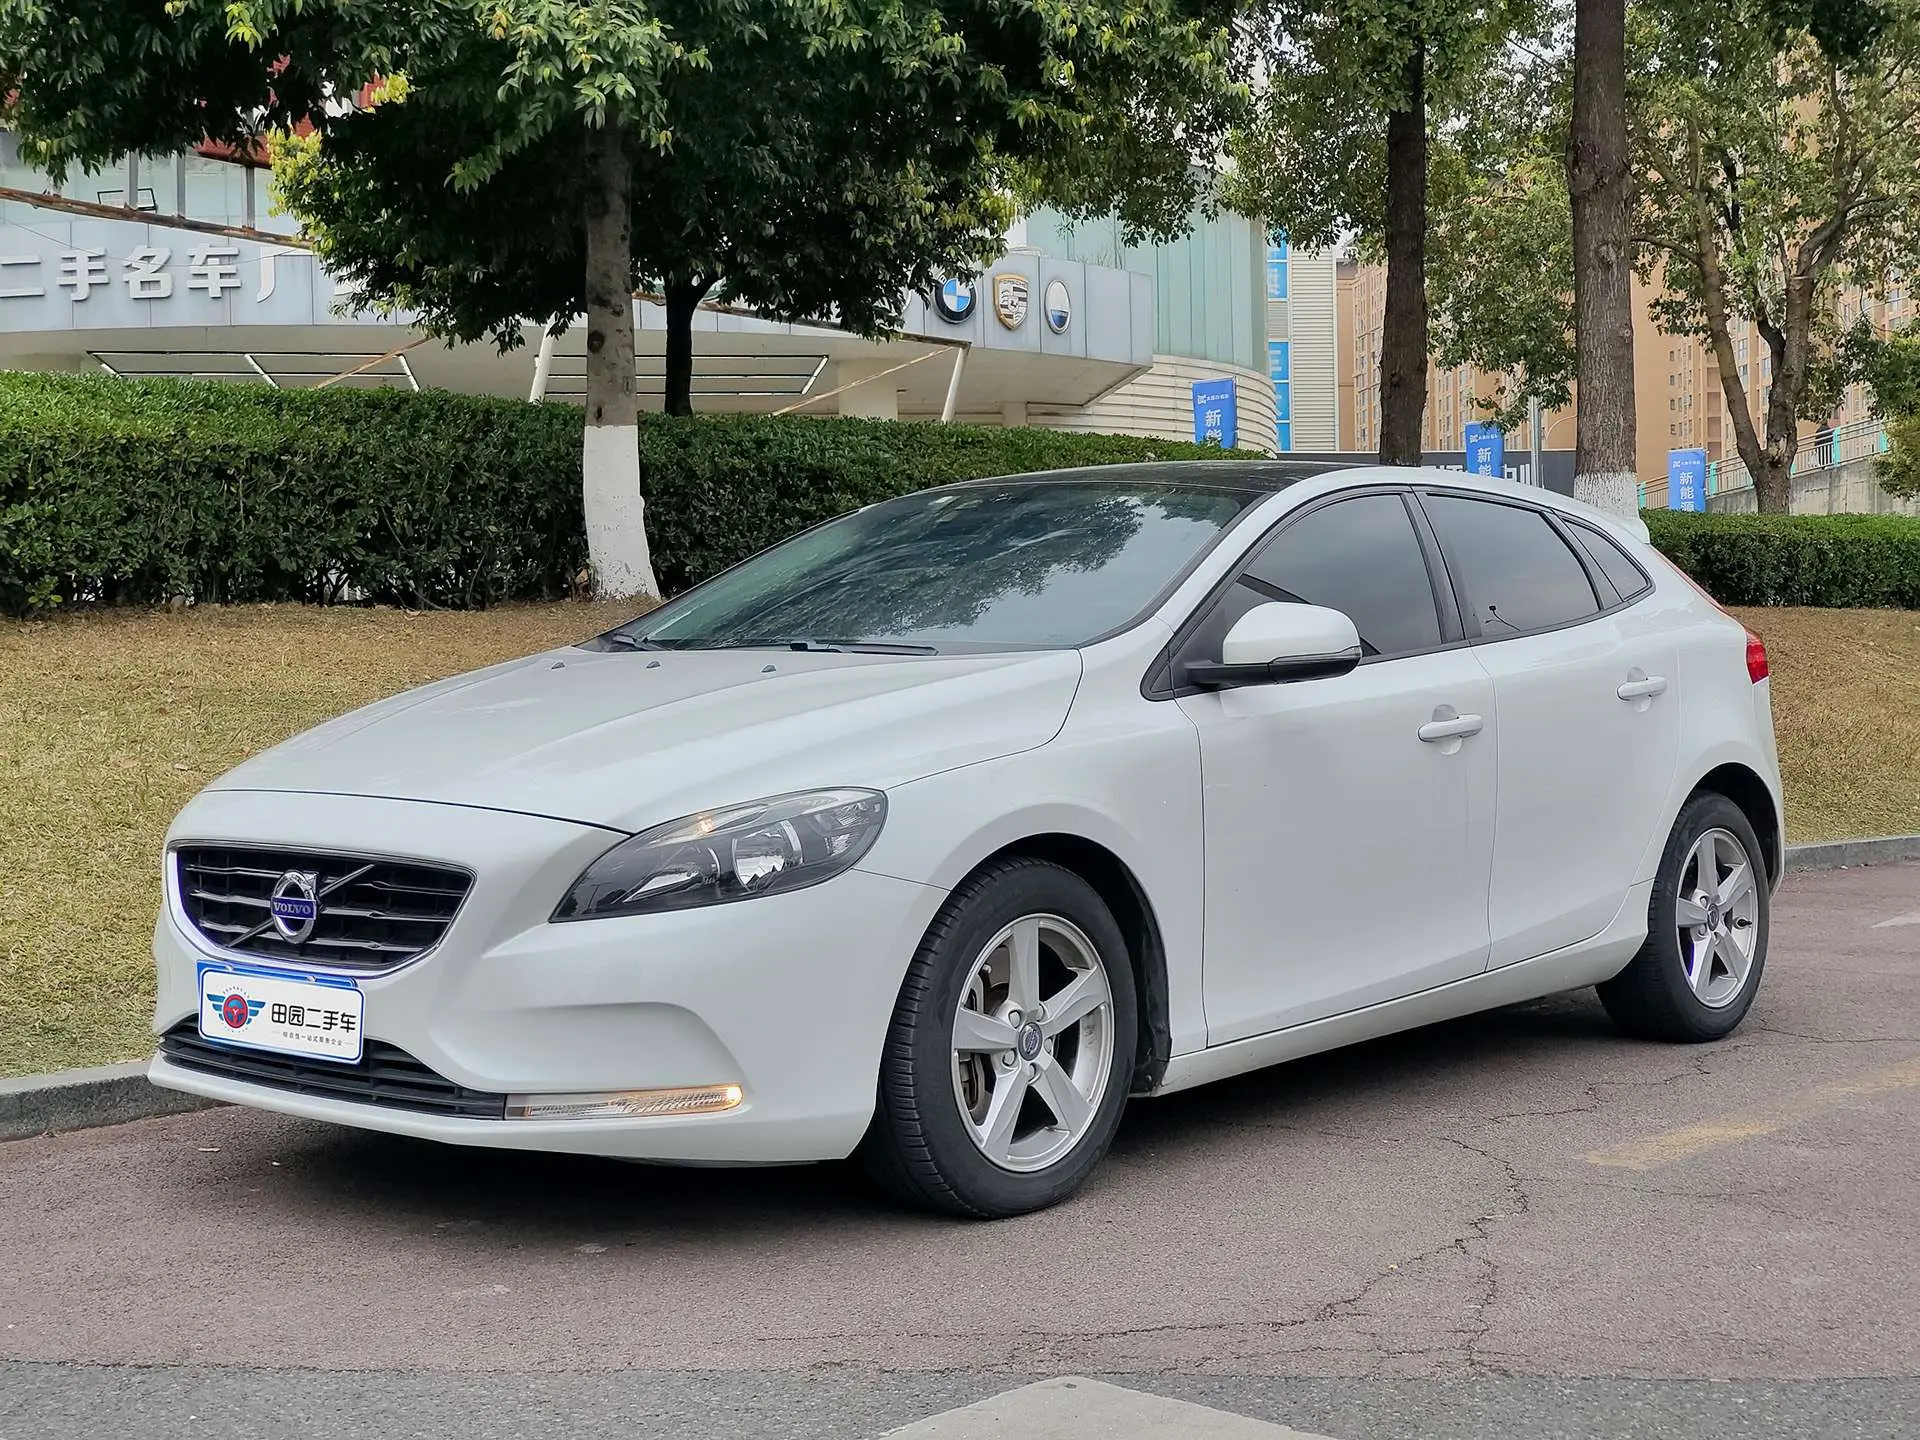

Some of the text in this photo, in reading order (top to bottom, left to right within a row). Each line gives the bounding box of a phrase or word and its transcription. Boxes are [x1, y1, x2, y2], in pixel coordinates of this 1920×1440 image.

[274, 902, 311, 915] VOLVO
[272, 1003, 356, 1033] 田园二手车
